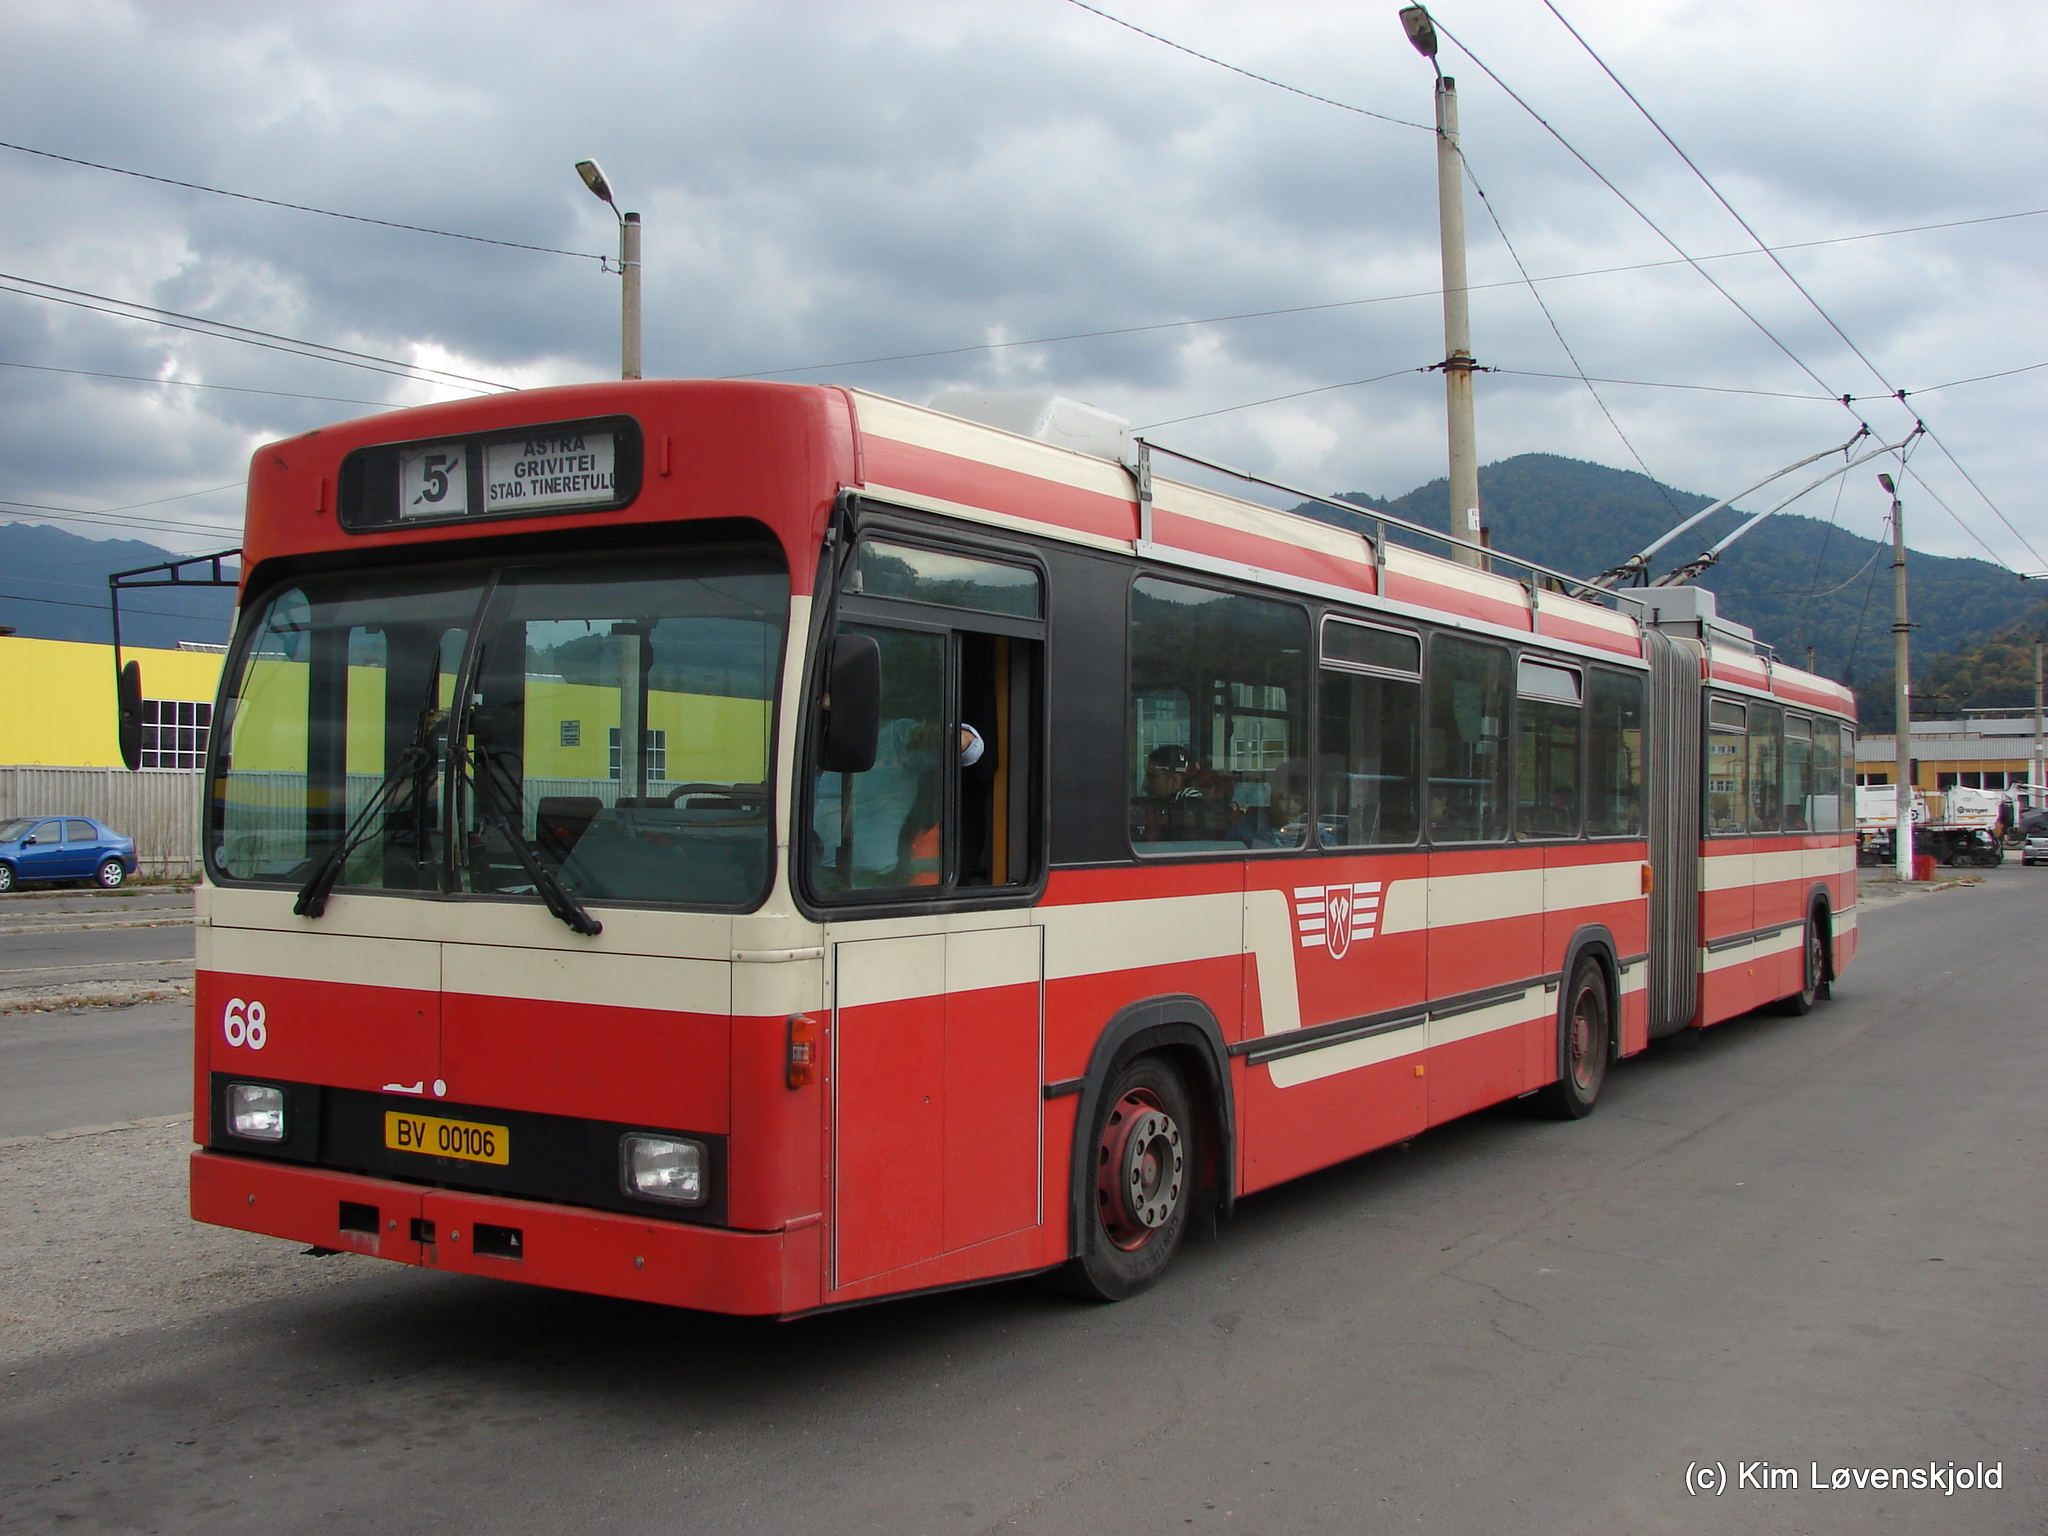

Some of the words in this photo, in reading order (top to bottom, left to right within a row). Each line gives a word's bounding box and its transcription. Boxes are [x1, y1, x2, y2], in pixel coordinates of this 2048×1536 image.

[523, 436, 586, 457] ASTRA
[514, 454, 596, 479] GRIVITEI
[490, 481, 527, 501] STAD.
[223, 997, 267, 1050] 68
[397, 1119, 426, 1148] BV
[438, 1124, 496, 1157] 00106
